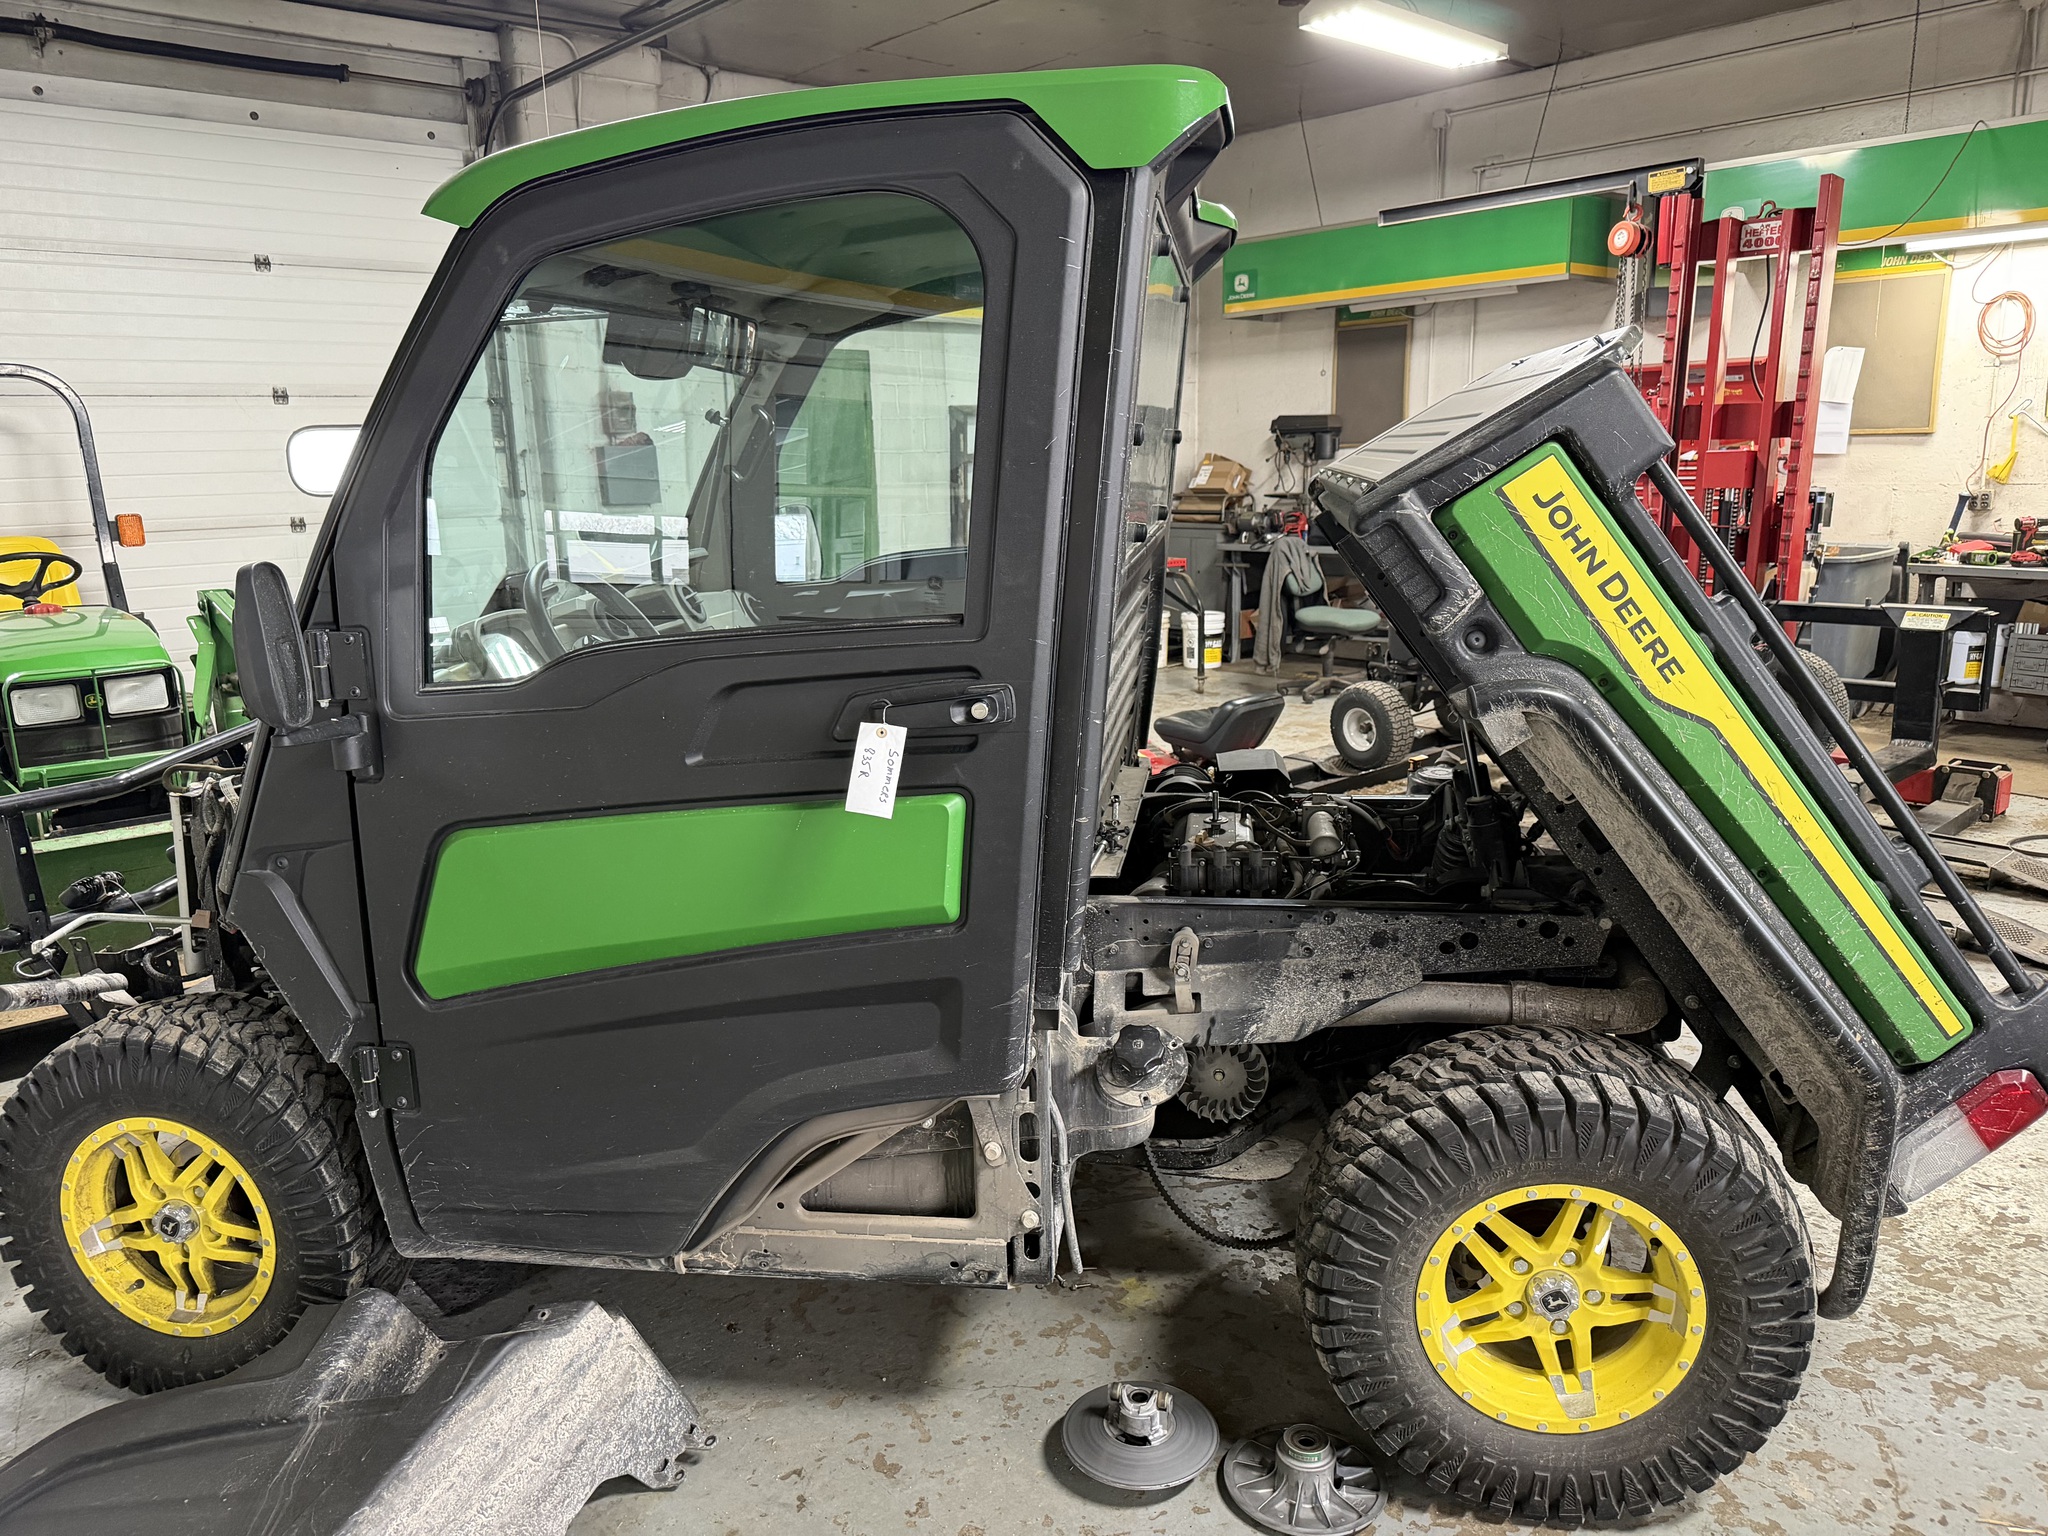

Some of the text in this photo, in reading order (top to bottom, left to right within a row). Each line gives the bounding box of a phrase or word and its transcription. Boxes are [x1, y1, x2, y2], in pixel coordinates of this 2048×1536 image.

[1883, 256, 1908, 268] JOHN
[1532, 491, 1686, 684] JOHN DEERE
[858, 747, 876, 778] 835R
